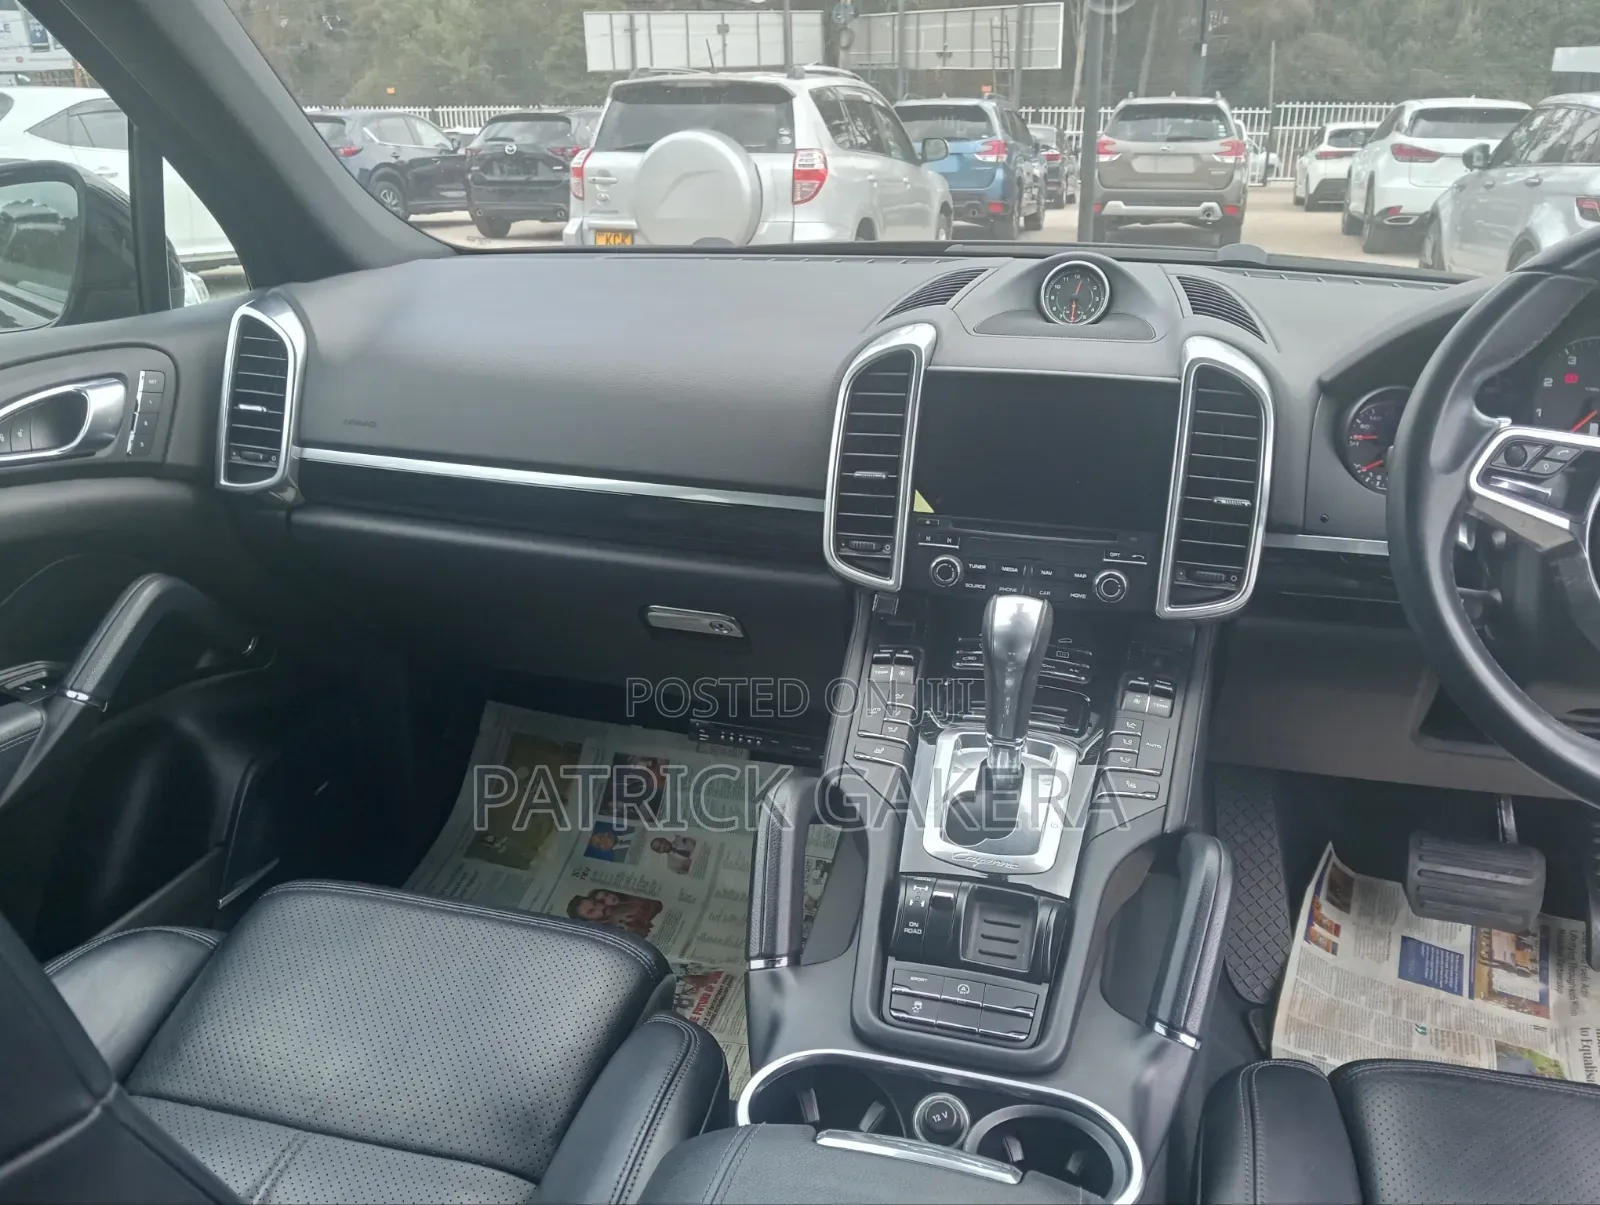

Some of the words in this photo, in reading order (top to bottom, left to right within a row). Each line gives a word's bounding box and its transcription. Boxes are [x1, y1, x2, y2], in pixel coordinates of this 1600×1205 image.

[1567, 355, 1577, 366] 3
[1543, 377, 1554, 388] 2
[1535, 407, 1542, 417] 1
[968, 562, 987, 571] TUNER
[964, 582, 987, 590] SOURCE
[1069, 592, 1087, 600] HOME
[951, 851, 1020, 870] Cayenne
[903, 927, 923, 935] ROAD
[1580, 1026, 1591, 1037] to
[932, 1113, 942, 1123] 12
[941, 1110, 948, 1119] V
